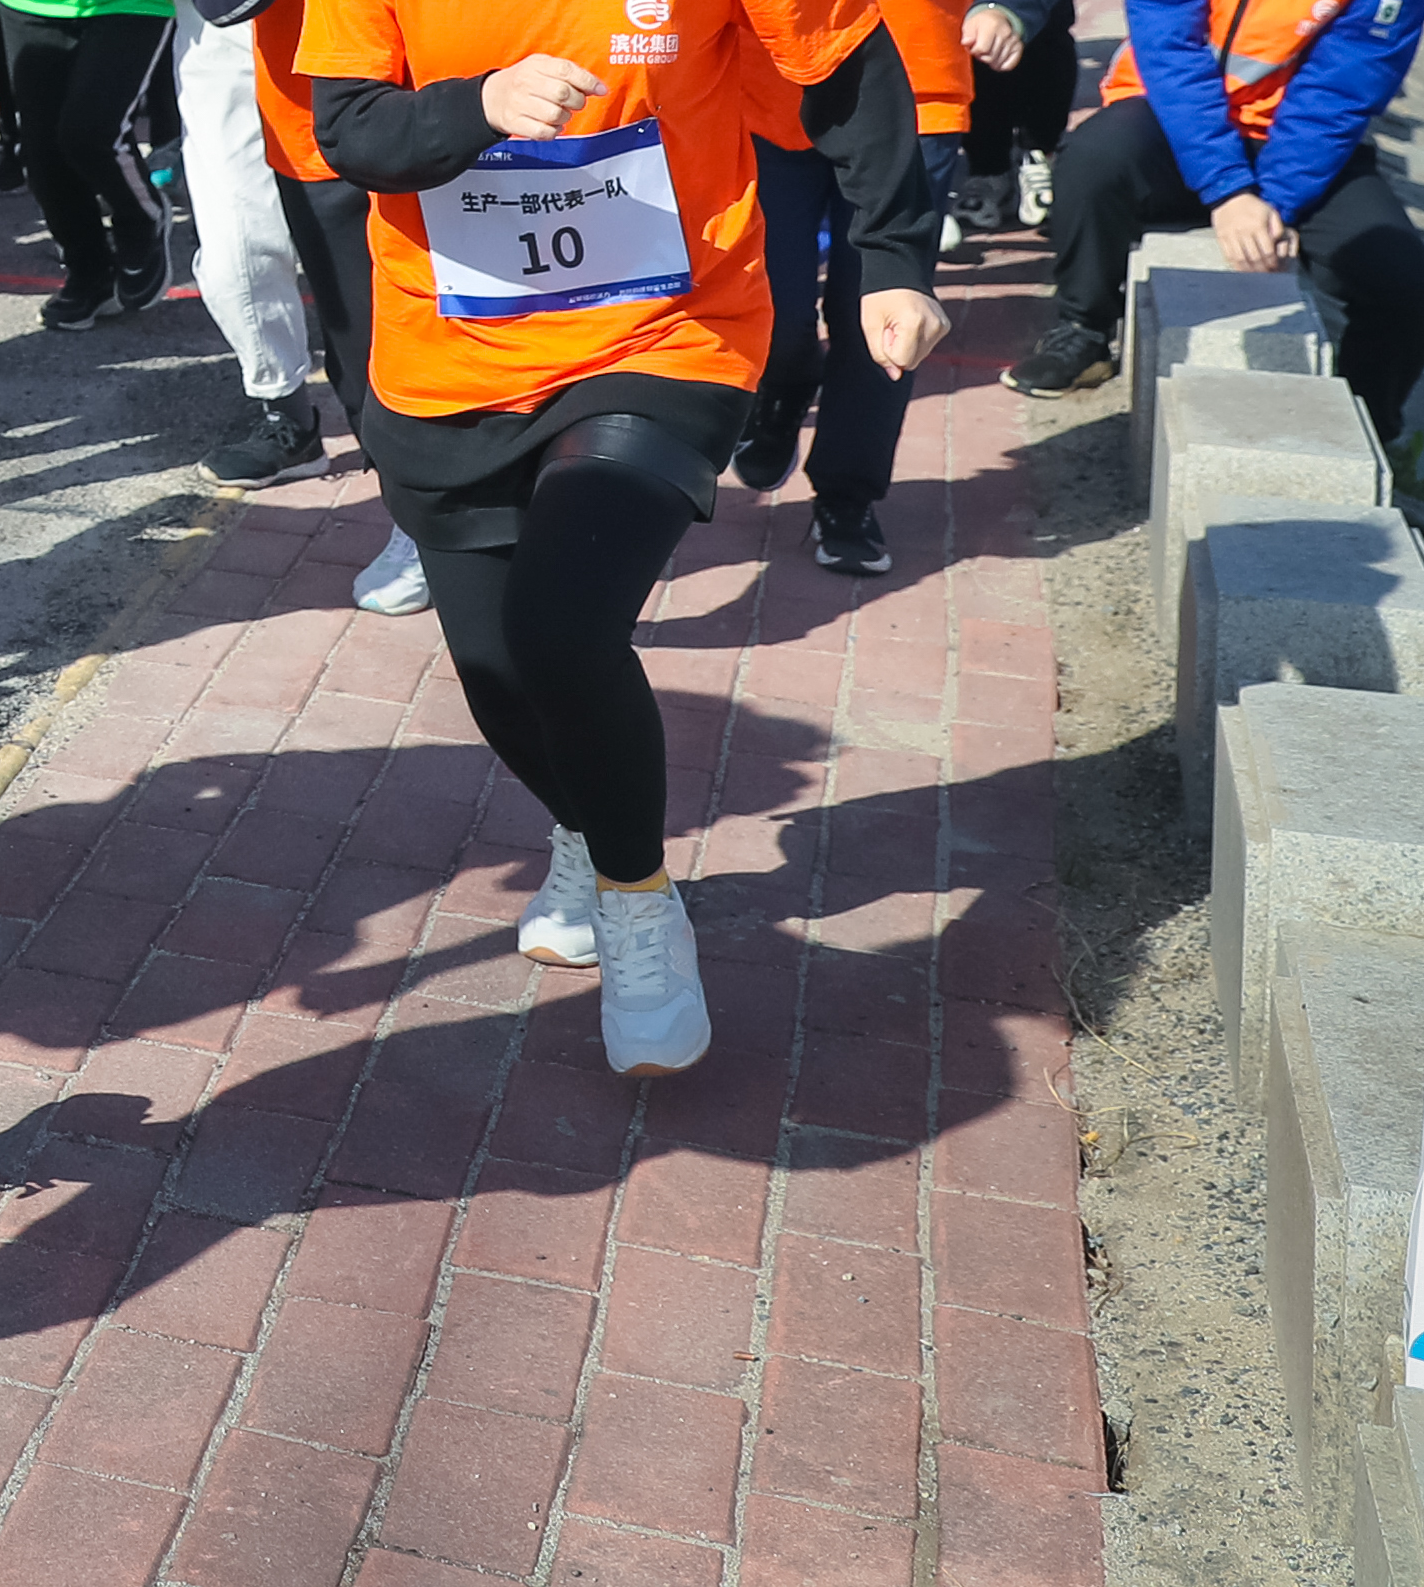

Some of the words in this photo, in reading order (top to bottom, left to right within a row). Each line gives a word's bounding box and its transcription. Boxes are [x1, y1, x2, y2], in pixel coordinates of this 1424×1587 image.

[610, 33, 679, 53] 滨化集团
[609, 54, 645, 64] BEFAR
[647, 54, 678, 64] GROUP
[461, 176, 628, 215] 生产一部代表一队
[518, 225, 585, 275] 10
